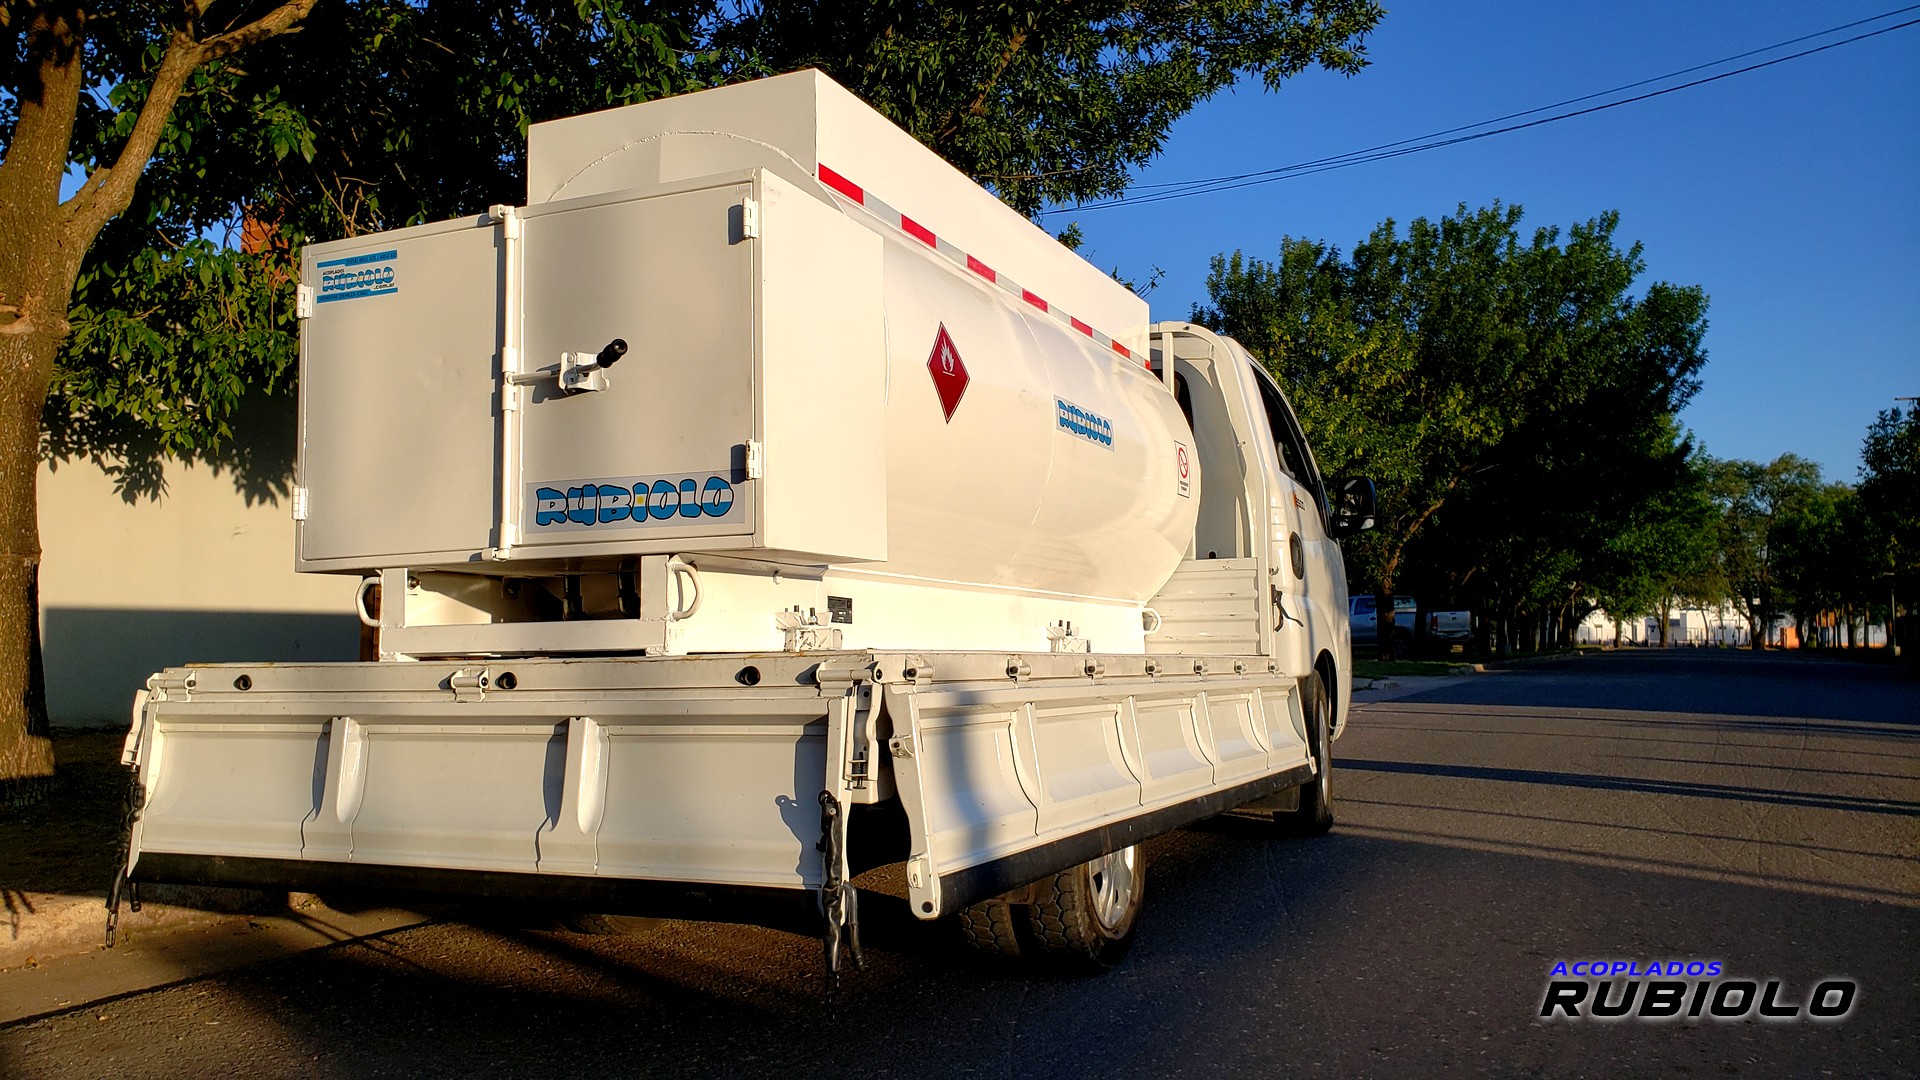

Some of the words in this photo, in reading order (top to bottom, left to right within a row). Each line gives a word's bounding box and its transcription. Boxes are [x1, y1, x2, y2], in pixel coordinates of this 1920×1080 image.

[322, 266, 395, 292] RUBIOLO
[1057, 400, 1112, 446] RUBIOLO
[535, 476, 734, 526] RUBIOLO
